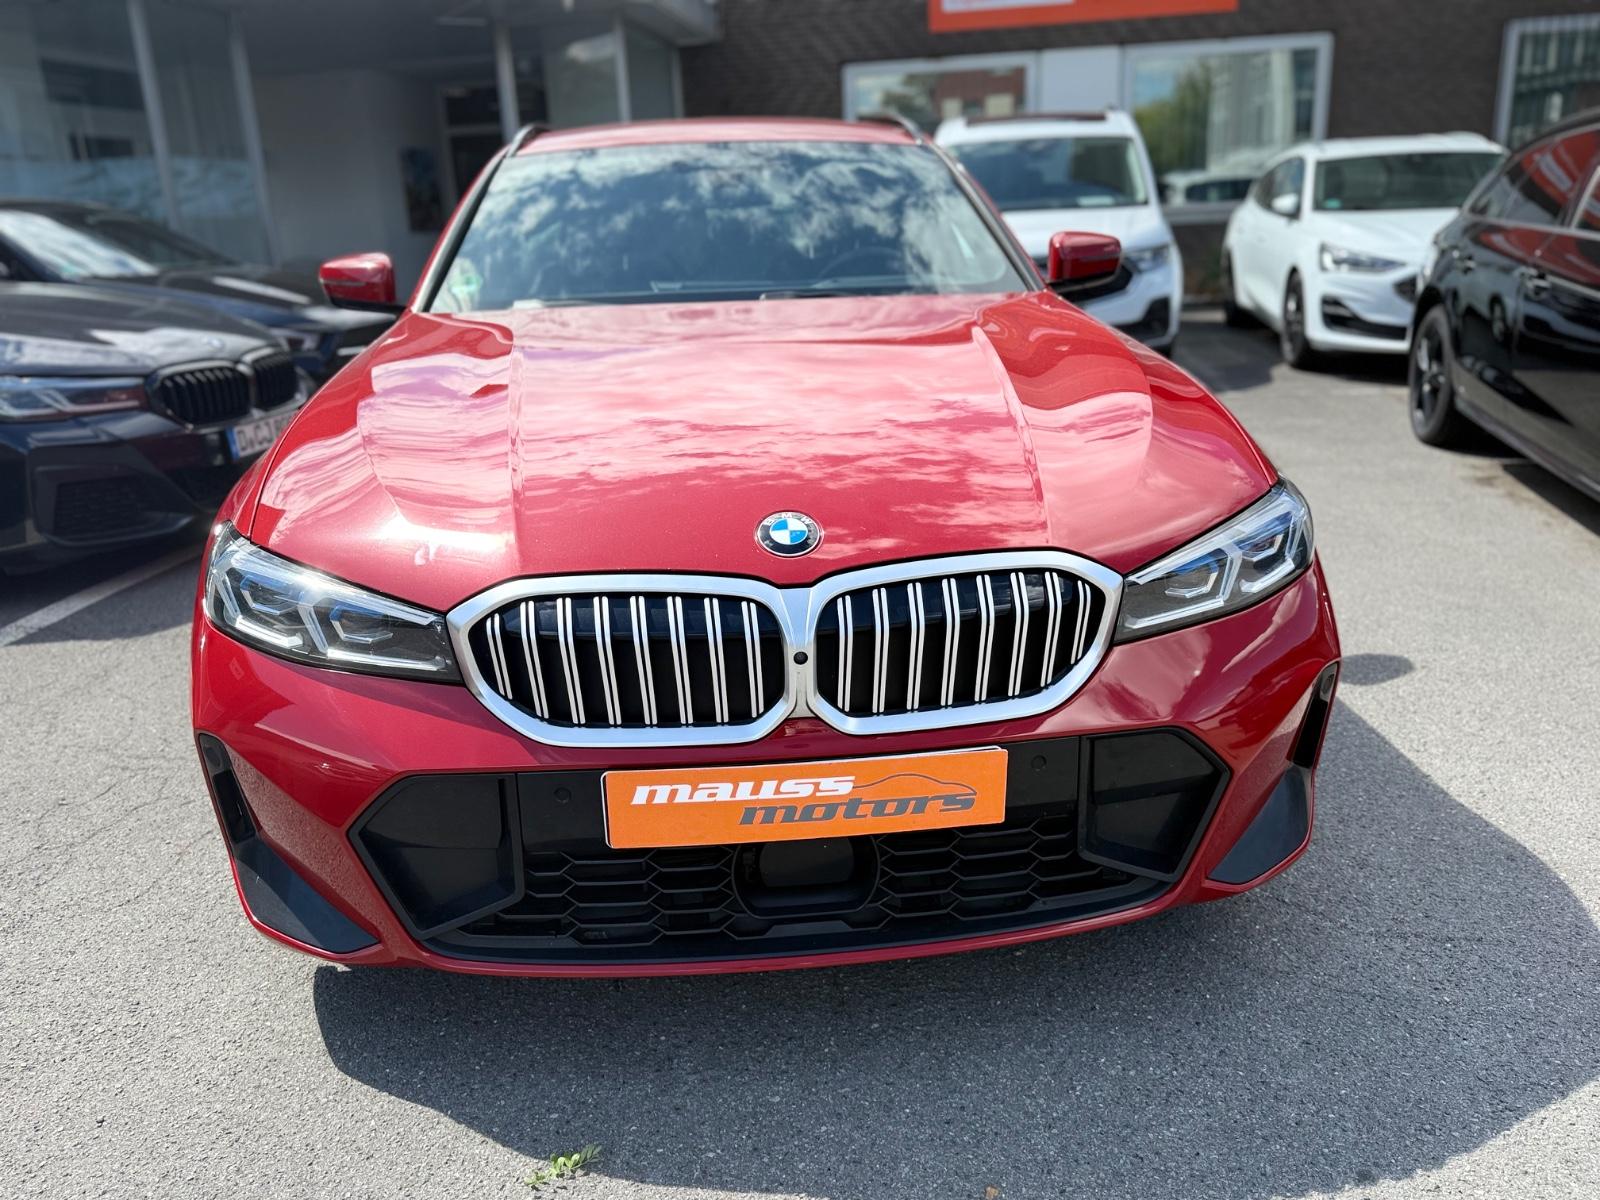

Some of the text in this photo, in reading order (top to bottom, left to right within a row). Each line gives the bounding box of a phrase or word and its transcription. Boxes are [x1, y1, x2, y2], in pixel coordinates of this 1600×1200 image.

[762, 512, 814, 526] BMW
[630, 776, 856, 805] mauss
[738, 792, 978, 825] motors
